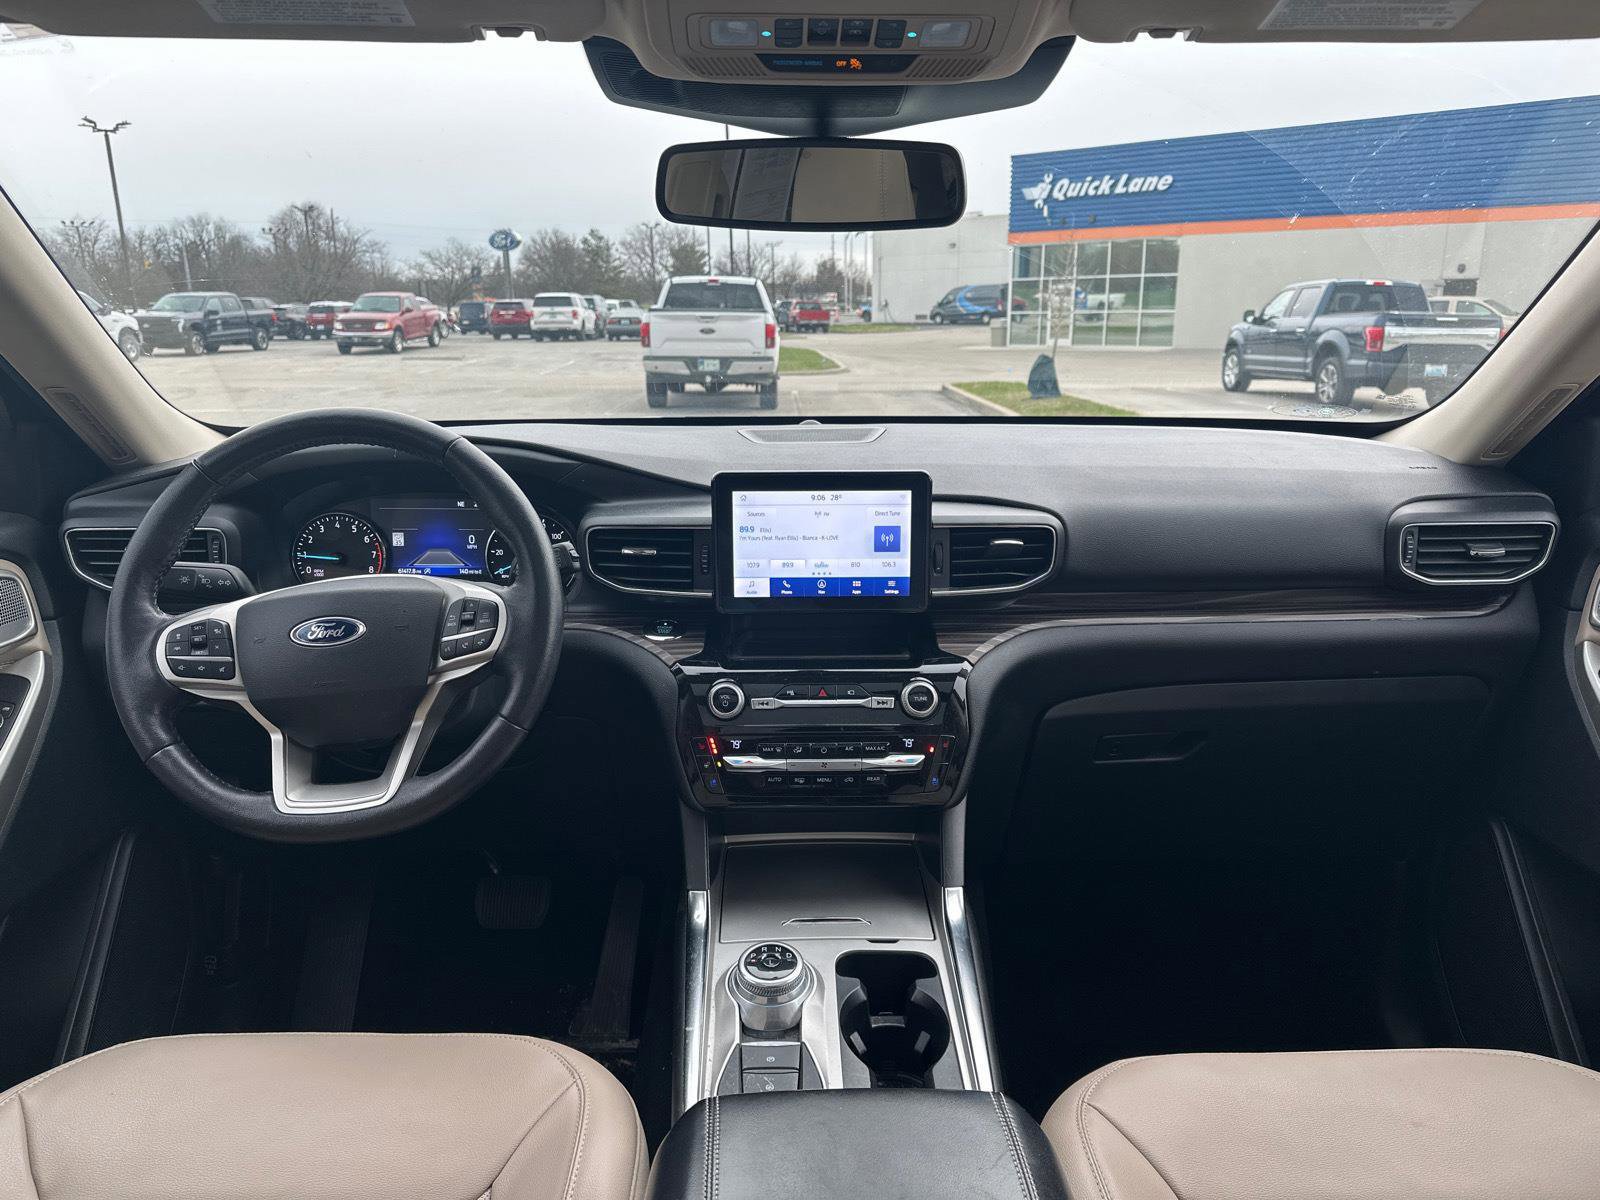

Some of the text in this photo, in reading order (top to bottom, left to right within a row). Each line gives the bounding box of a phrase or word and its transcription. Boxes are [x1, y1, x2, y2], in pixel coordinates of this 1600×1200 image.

[1052, 173, 1173, 201] Quick Lane
[319, 525, 324, 533] 3
[351, 525, 357, 533] 5
[468, 535, 475, 544] 0
[307, 621, 345, 640] Ford
